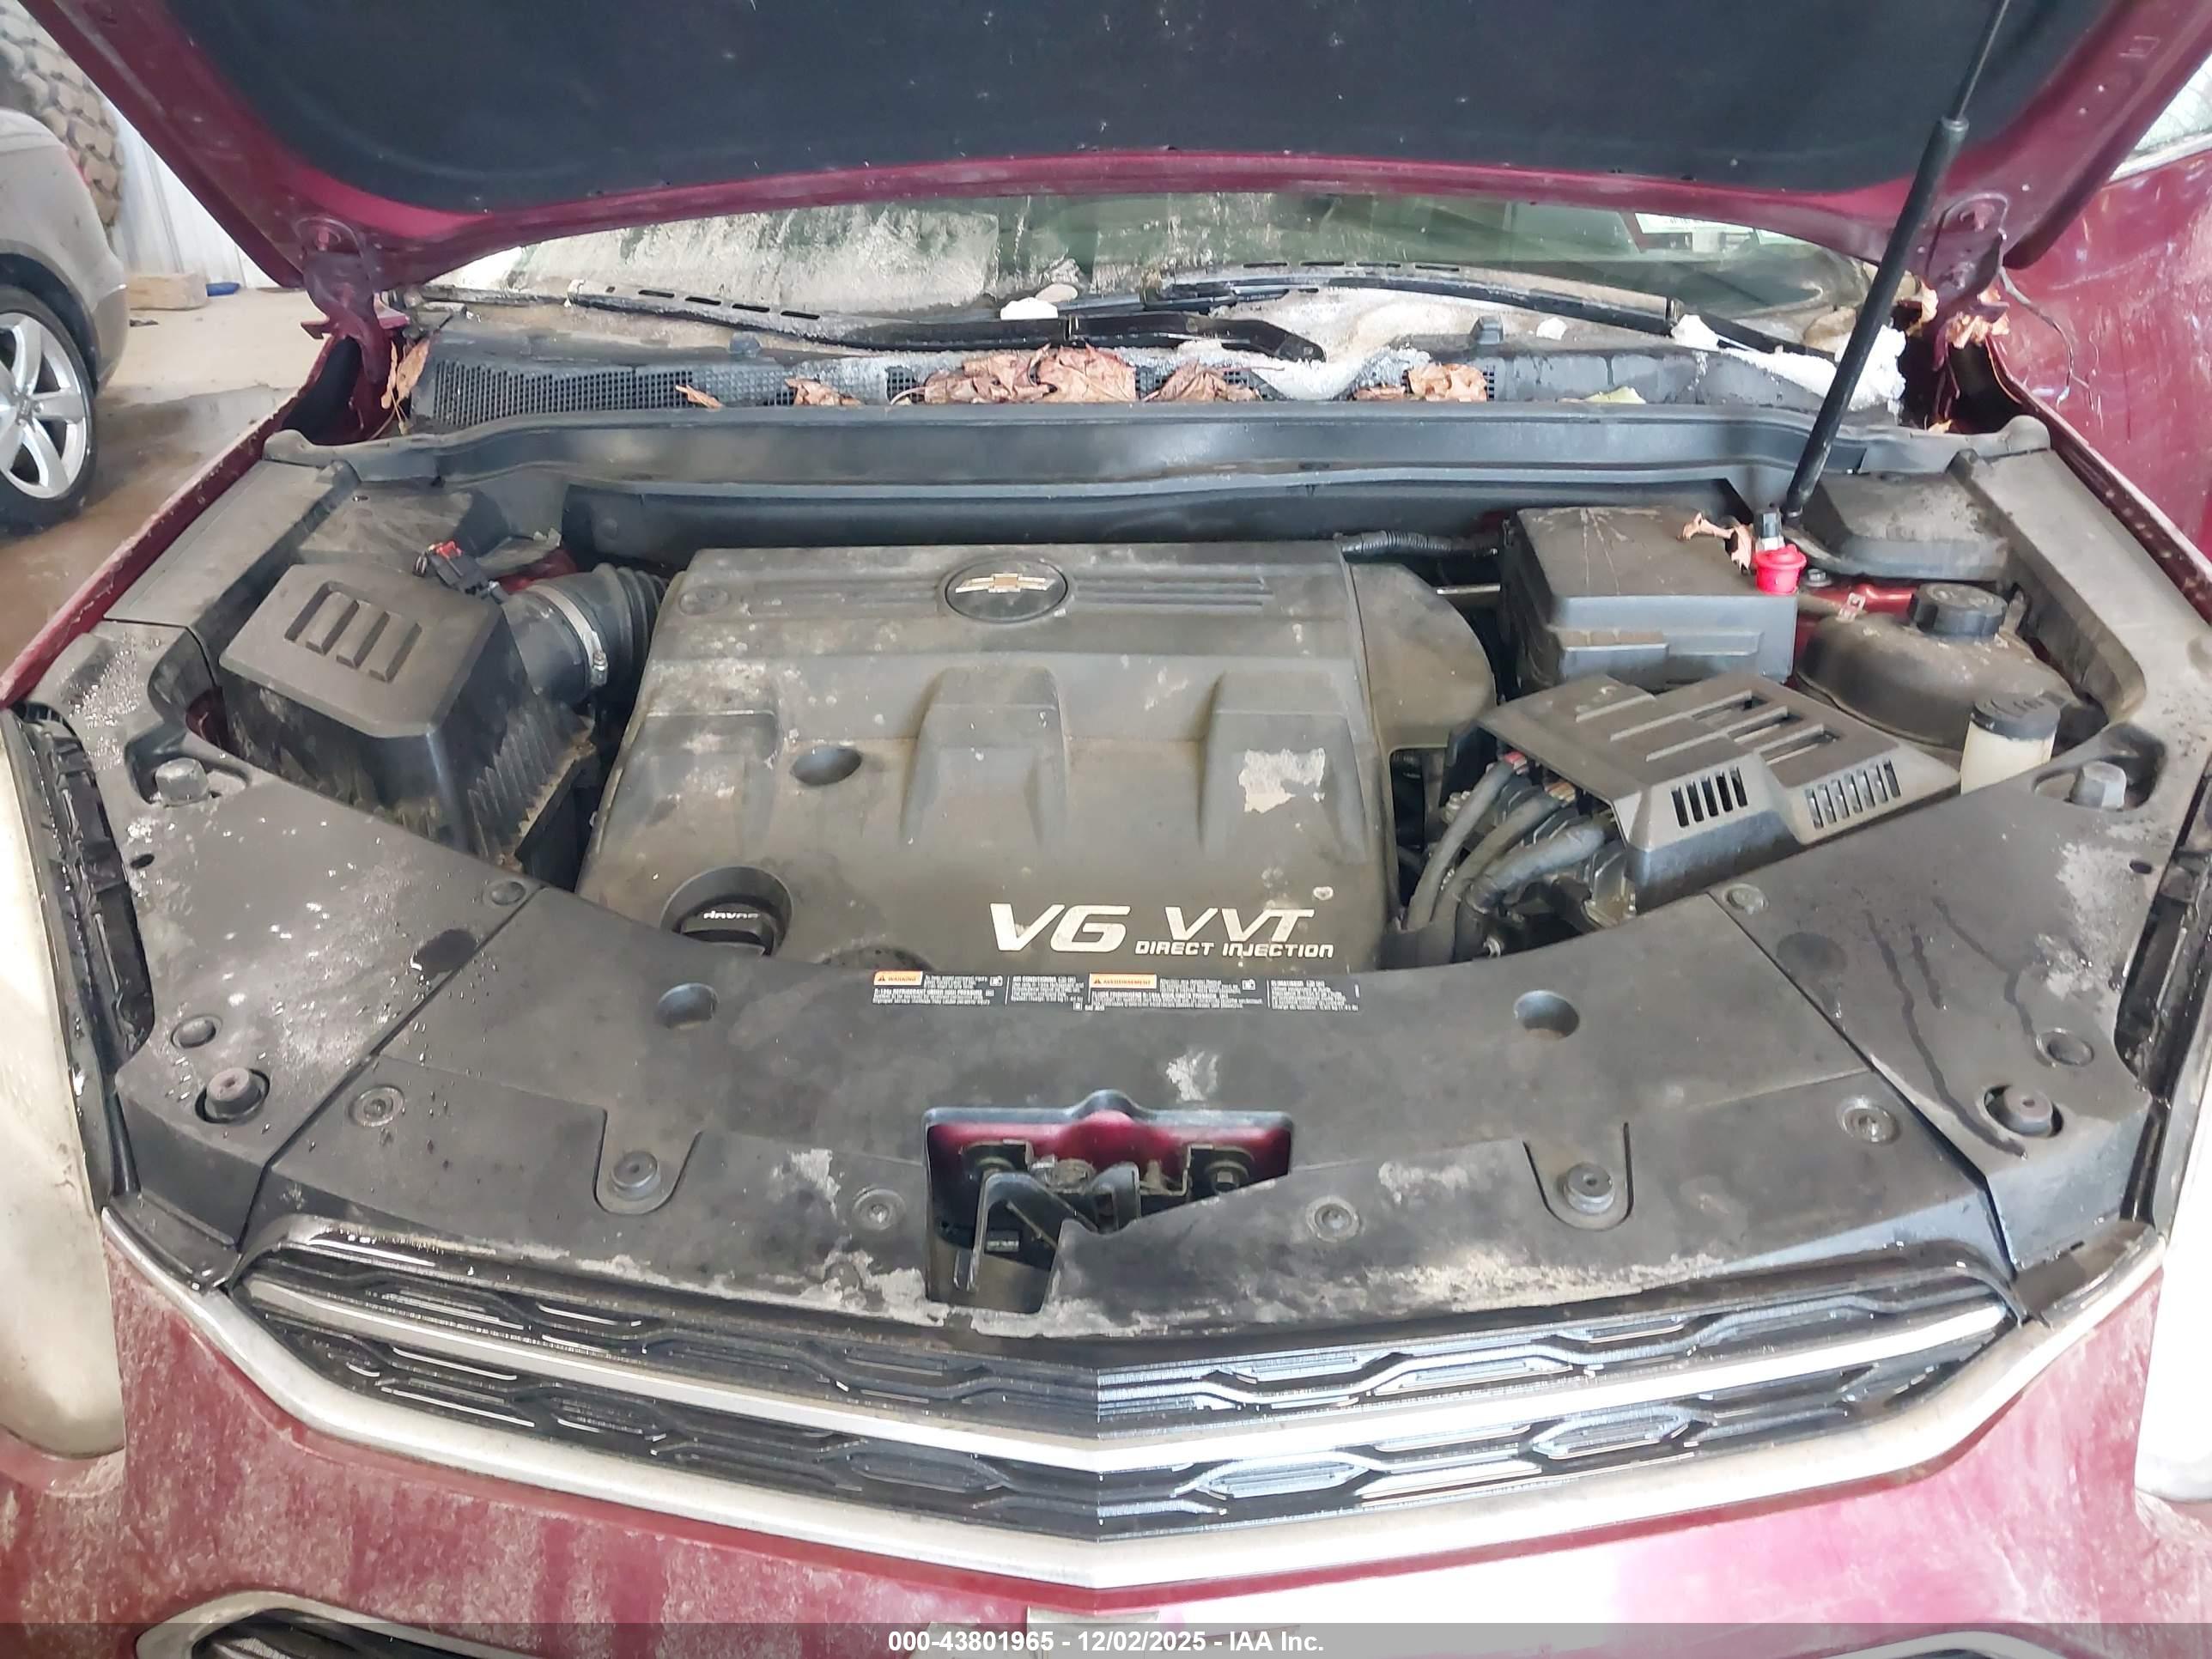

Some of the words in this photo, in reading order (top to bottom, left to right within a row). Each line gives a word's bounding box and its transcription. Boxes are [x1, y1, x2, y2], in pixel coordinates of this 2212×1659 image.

[989, 902, 1131, 952] V6
[1164, 906, 1315, 942] VVT
[1134, 941, 1214, 956] DIRECT
[1222, 943, 1334, 958] INJECTION
